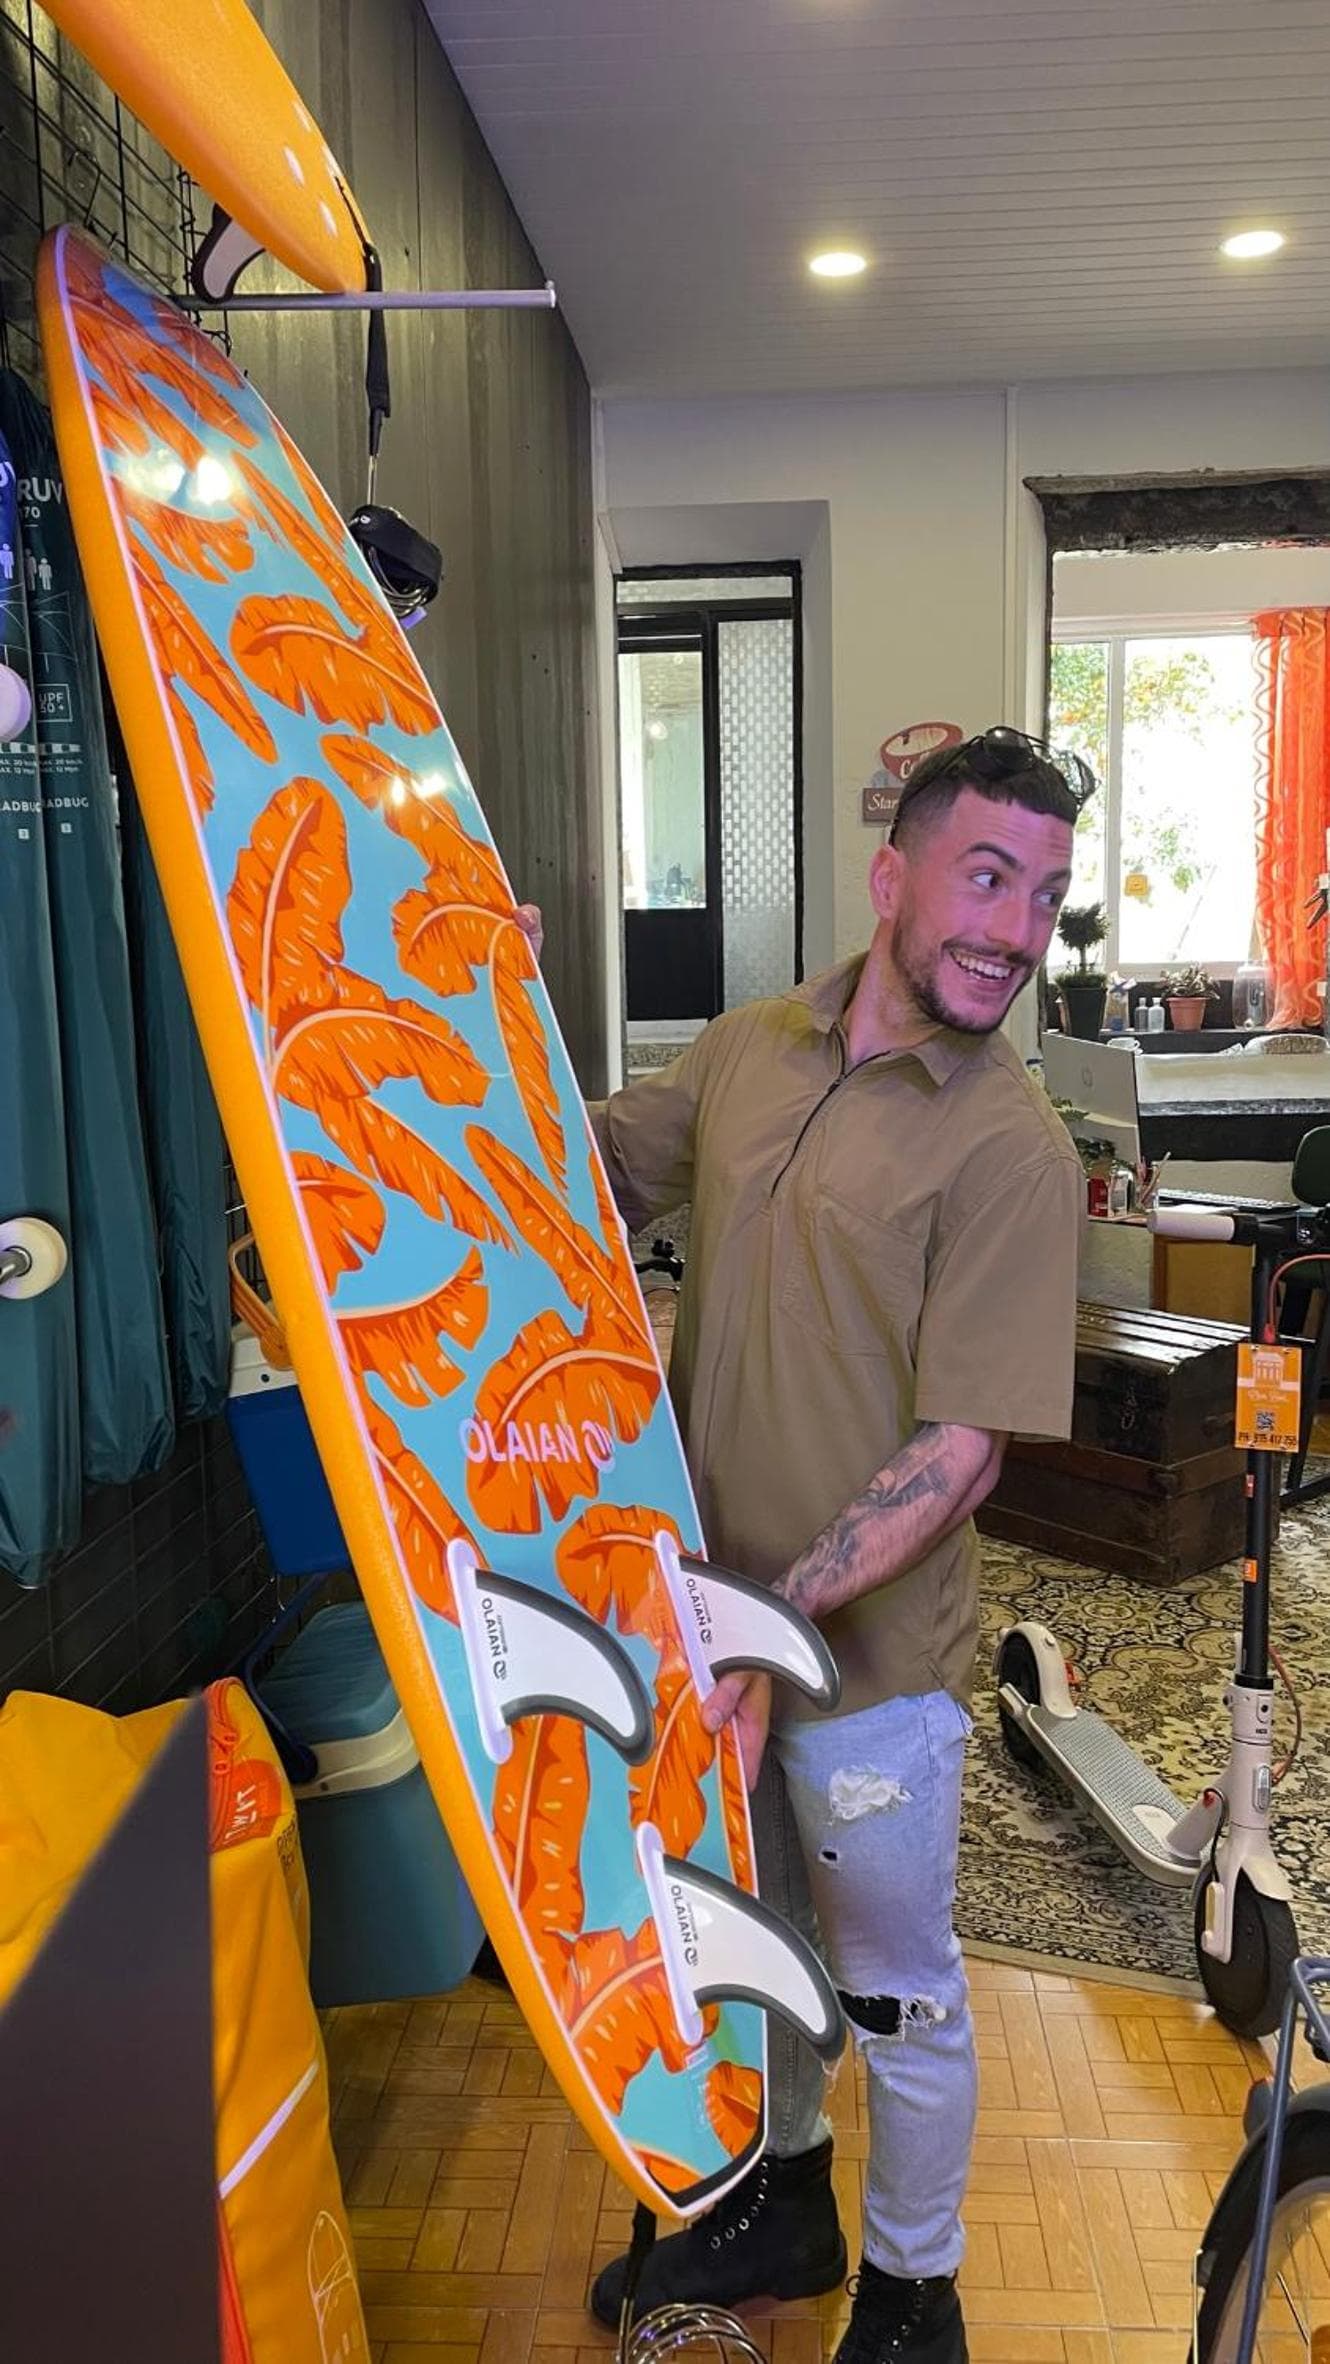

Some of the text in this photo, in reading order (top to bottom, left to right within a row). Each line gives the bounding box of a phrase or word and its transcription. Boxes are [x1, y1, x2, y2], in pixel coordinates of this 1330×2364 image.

[39, 692, 64, 702] UPF
[0, 800, 42, 813] ADBUG
[42, 796, 89, 809] ADBUG
[459, 1418, 582, 1463] OLAIAN
[686, 1579, 706, 1626] OLAIAN
[481, 1598, 502, 1657] OLAIAN
[671, 1885, 693, 1943] OLAIAN
